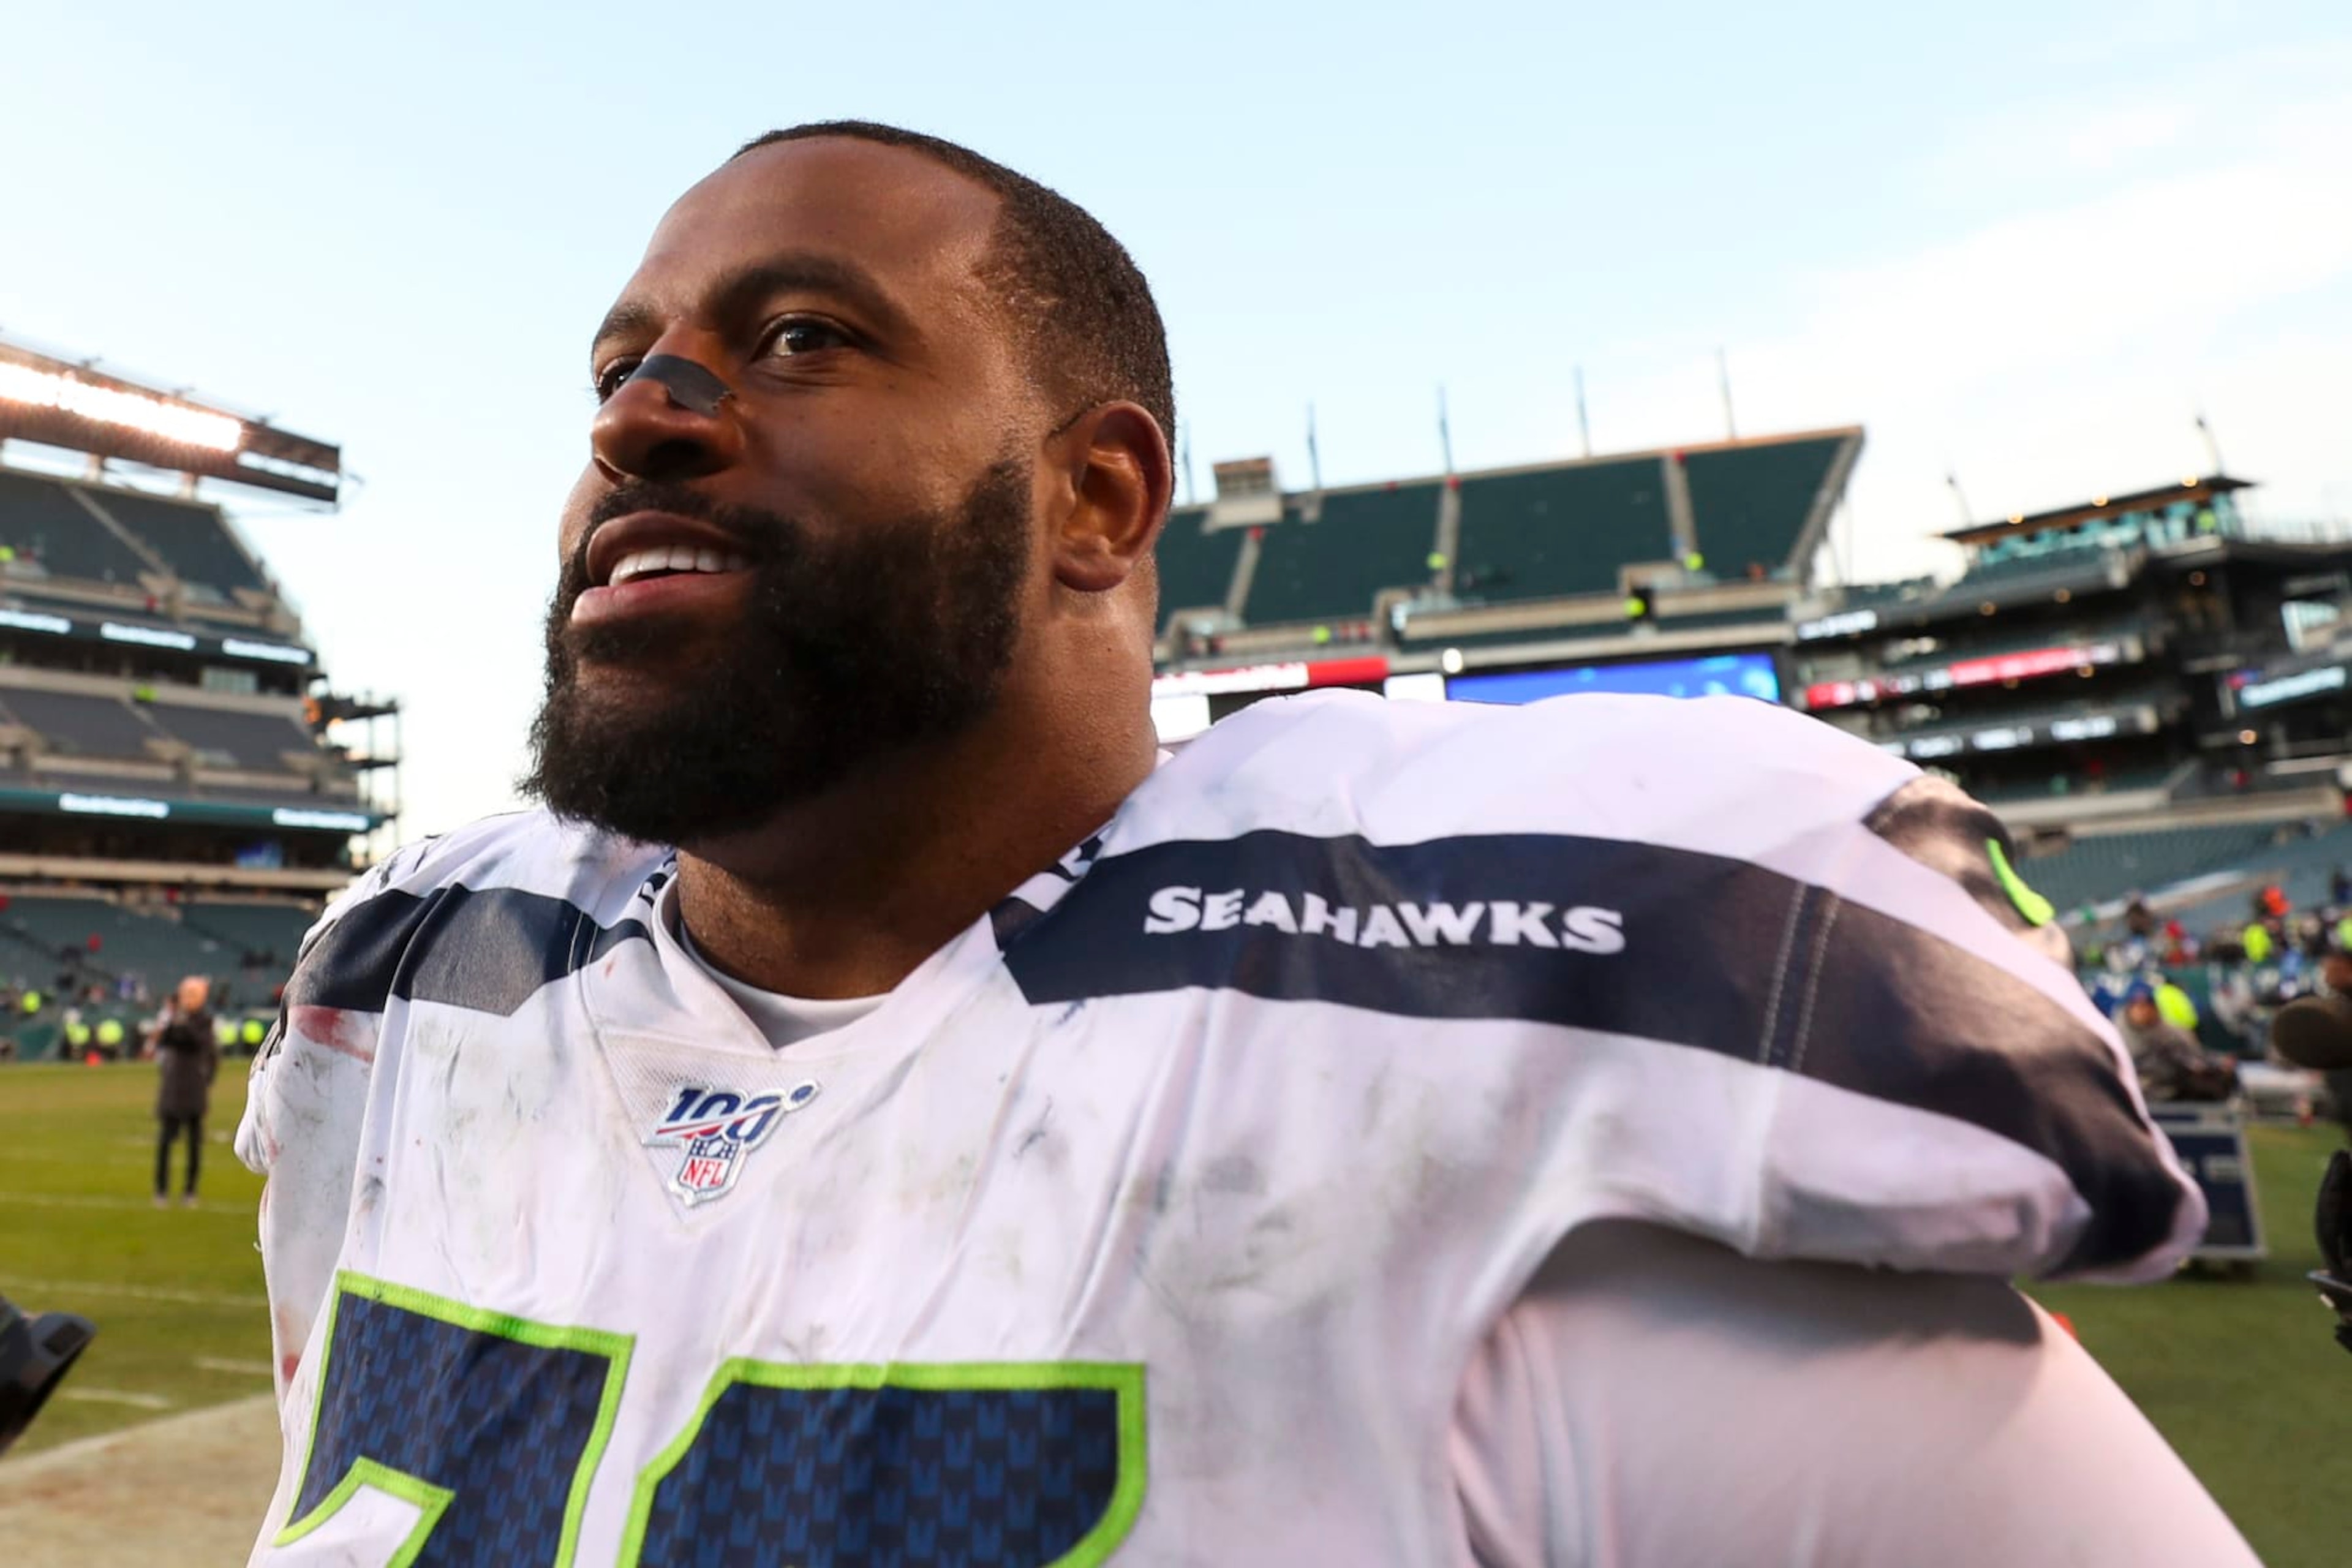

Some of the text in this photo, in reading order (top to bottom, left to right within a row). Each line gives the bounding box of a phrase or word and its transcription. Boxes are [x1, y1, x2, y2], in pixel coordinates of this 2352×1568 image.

[1144, 886, 1626, 955] SEAHAWKS
[665, 1088, 783, 1144] 100
[682, 1158, 724, 1188] NFL
